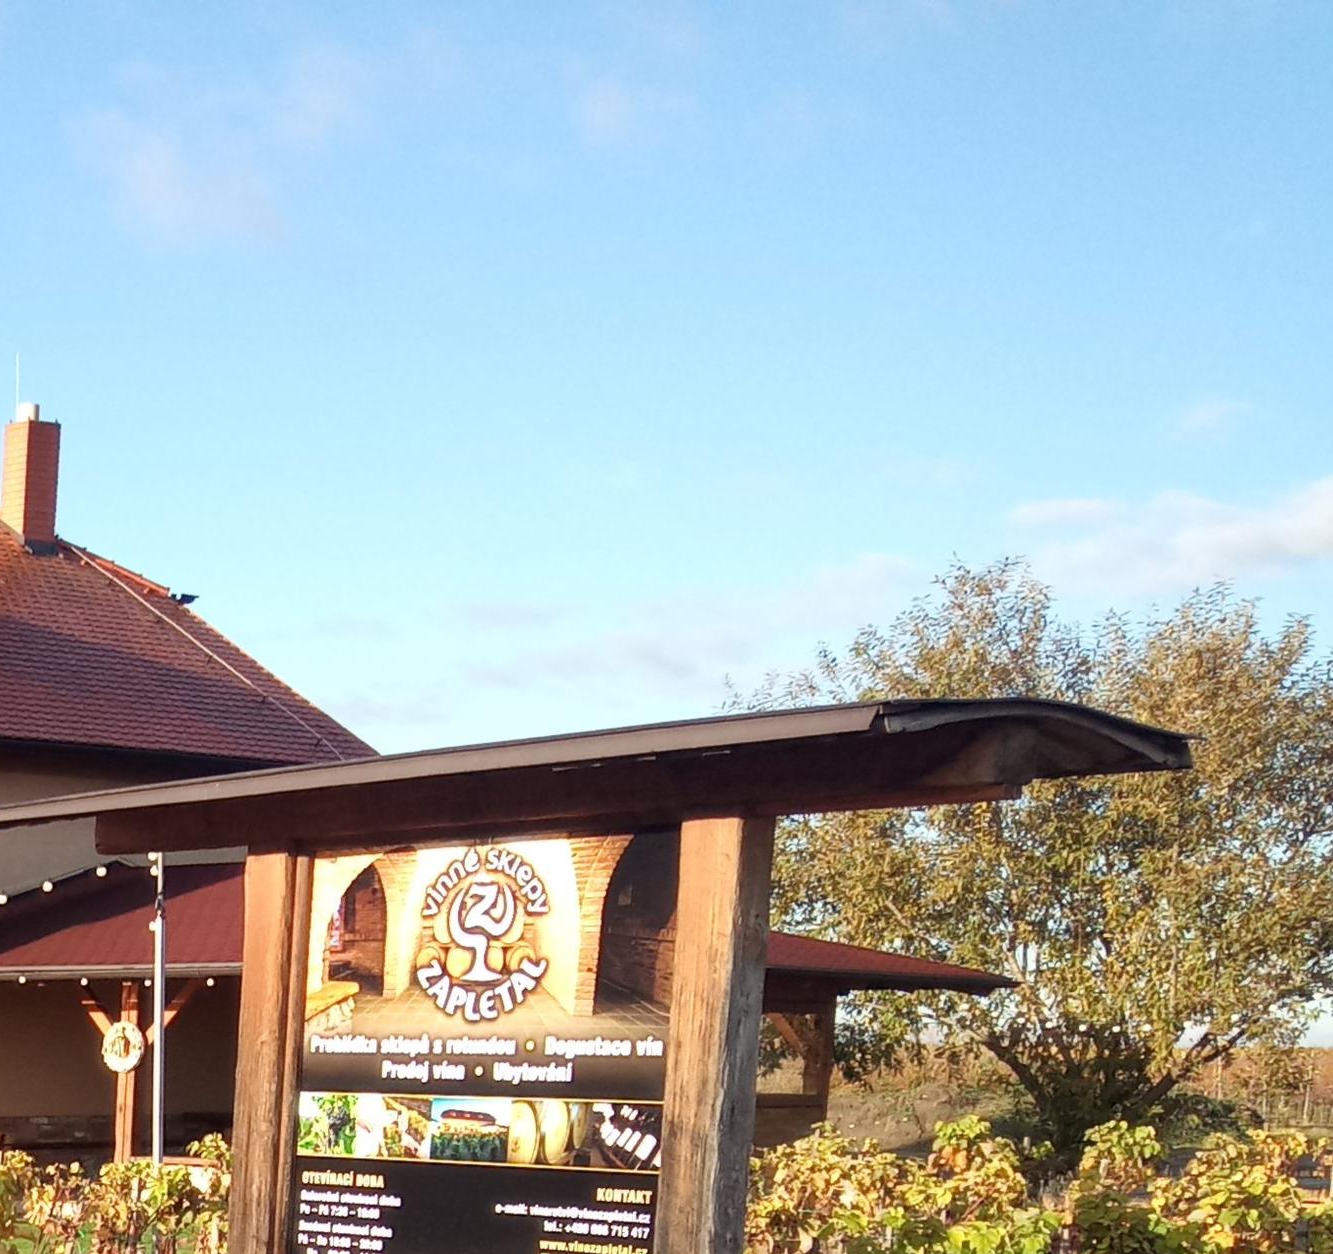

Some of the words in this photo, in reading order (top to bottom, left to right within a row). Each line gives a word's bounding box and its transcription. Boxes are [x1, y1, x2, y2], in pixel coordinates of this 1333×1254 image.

[416, 957, 548, 1022] ZAPLETAL
[433, 1038, 444, 1055] s
[544, 1035, 632, 1060] Degustace
[382, 1060, 430, 1084] Prodej
[493, 1062, 573, 1086] Ubytování
[302, 1170, 354, 1187] OTEVÍRACÍ
[356, 1174, 385, 1189] DOBA
[596, 1187, 653, 1205] KONTAKT
[611, 1225, 630, 1239] 715
[631, 1227, 650, 1240] 417
